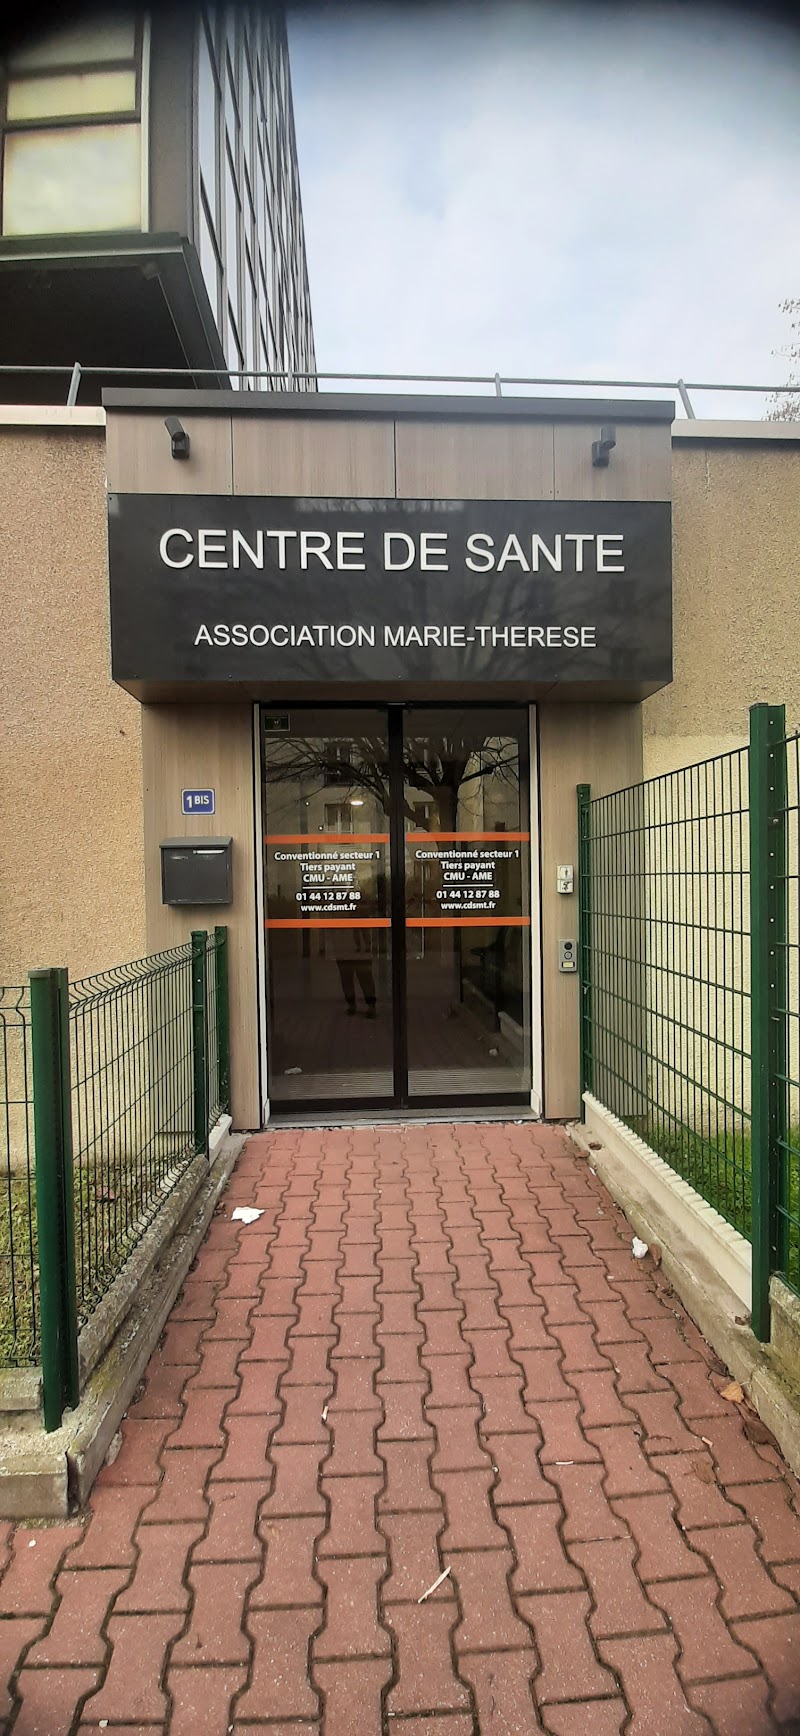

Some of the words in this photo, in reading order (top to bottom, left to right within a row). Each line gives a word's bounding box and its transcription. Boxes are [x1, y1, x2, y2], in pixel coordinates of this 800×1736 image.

[159, 528, 366, 571] CENTRE
[383, 532, 449, 571] DE
[465, 533, 625, 572] SANTE
[194, 624, 375, 647] ASSOCIATION
[384, 625, 597, 648] MARIE-THERESE
[186, 795, 193, 808] 1
[194, 795, 210, 805] BIS
[274, 851, 339, 861] Conventionné
[340, 852, 374, 860] secteur
[375, 851, 380, 859] 1
[415, 849, 478, 859] Conventionné
[479, 850, 513, 858] secteur
[514, 850, 519, 858] 1
[299, 863, 323, 872] Tiers
[323, 863, 356, 873] payant
[440, 861, 463, 870] Tiers
[463, 861, 496, 871] payant
[303, 874, 325, 883] CMU
[331, 874, 354, 883] AME
[443, 872, 465, 881] CMU
[471, 872, 493, 881] AME
[295, 892, 307, 901] 01
[309, 892, 321, 901] 44
[323, 892, 335, 900] 12
[335, 892, 348, 900] 87
[348, 891, 361, 900] 88
[436, 890, 447, 899] 01
[449, 890, 461, 899] 44
[463, 890, 474, 899] 12
[475, 890, 487, 898] 87
[488, 890, 500, 898] 88
[300, 902, 357, 912] www.cdsmt.fr
[440, 900, 496, 910] www.cdsmt.fr
